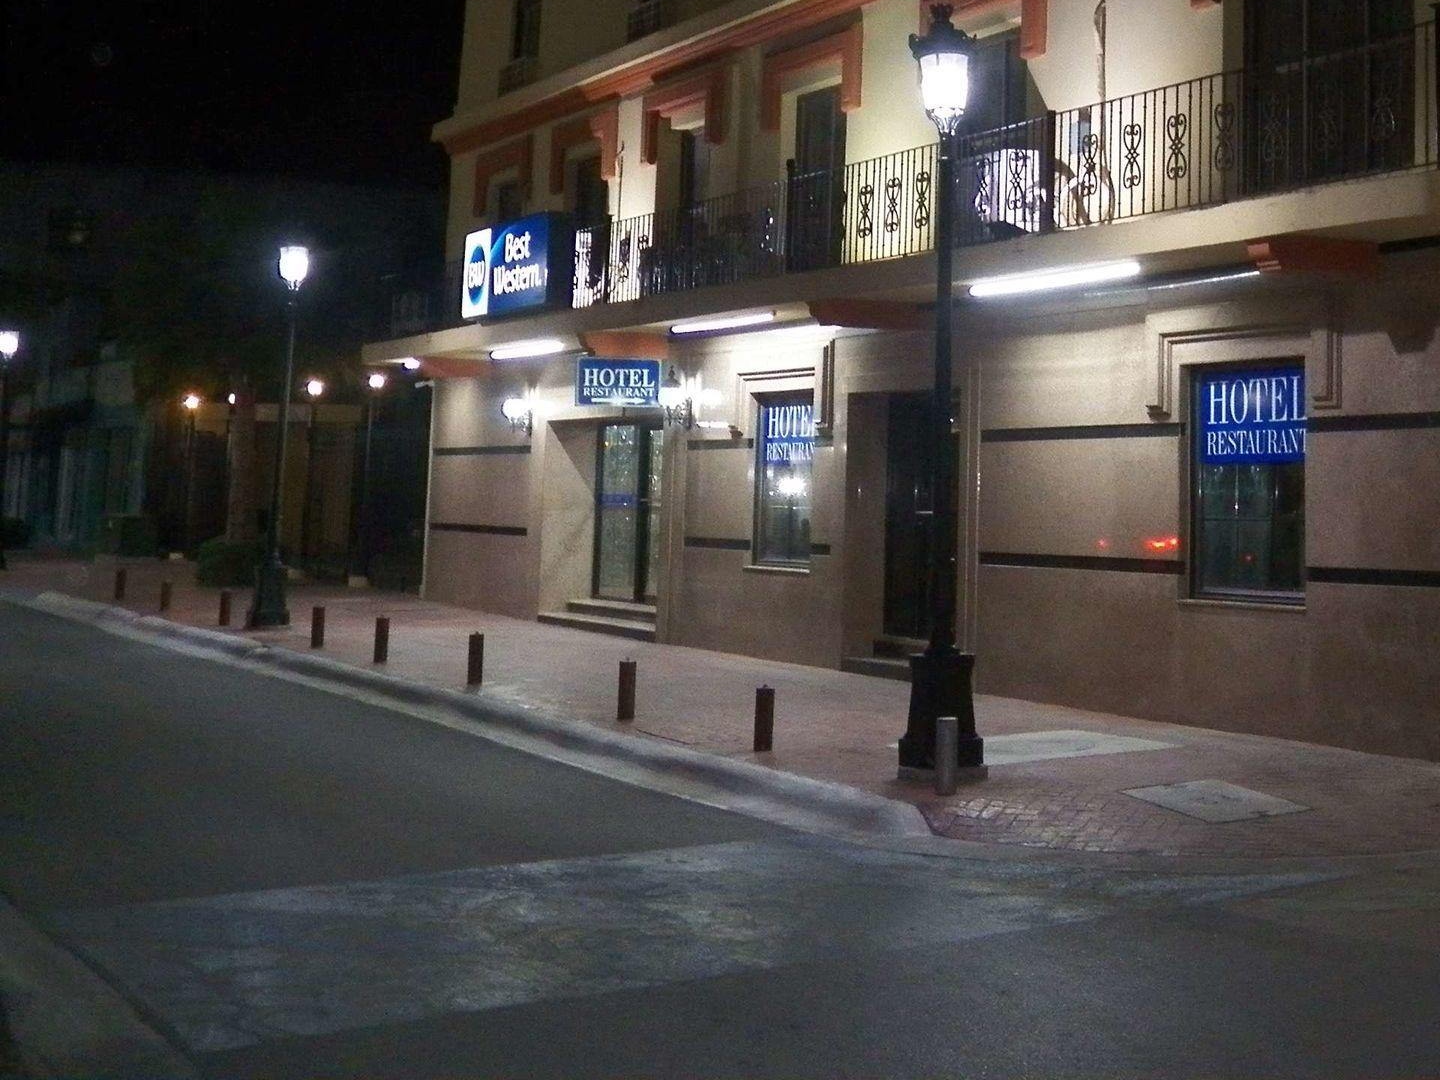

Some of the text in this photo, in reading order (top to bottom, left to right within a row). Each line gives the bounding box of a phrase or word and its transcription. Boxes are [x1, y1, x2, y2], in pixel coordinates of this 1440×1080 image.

[504, 231, 531, 263] Best
[584, 368, 655, 388] HOTEL
[583, 387, 655, 397] RESTAURANT
[1207, 375, 1308, 425] HOTEL
[766, 441, 816, 461] RESTAURAN
[1207, 428, 1307, 456] RESTAURANT
